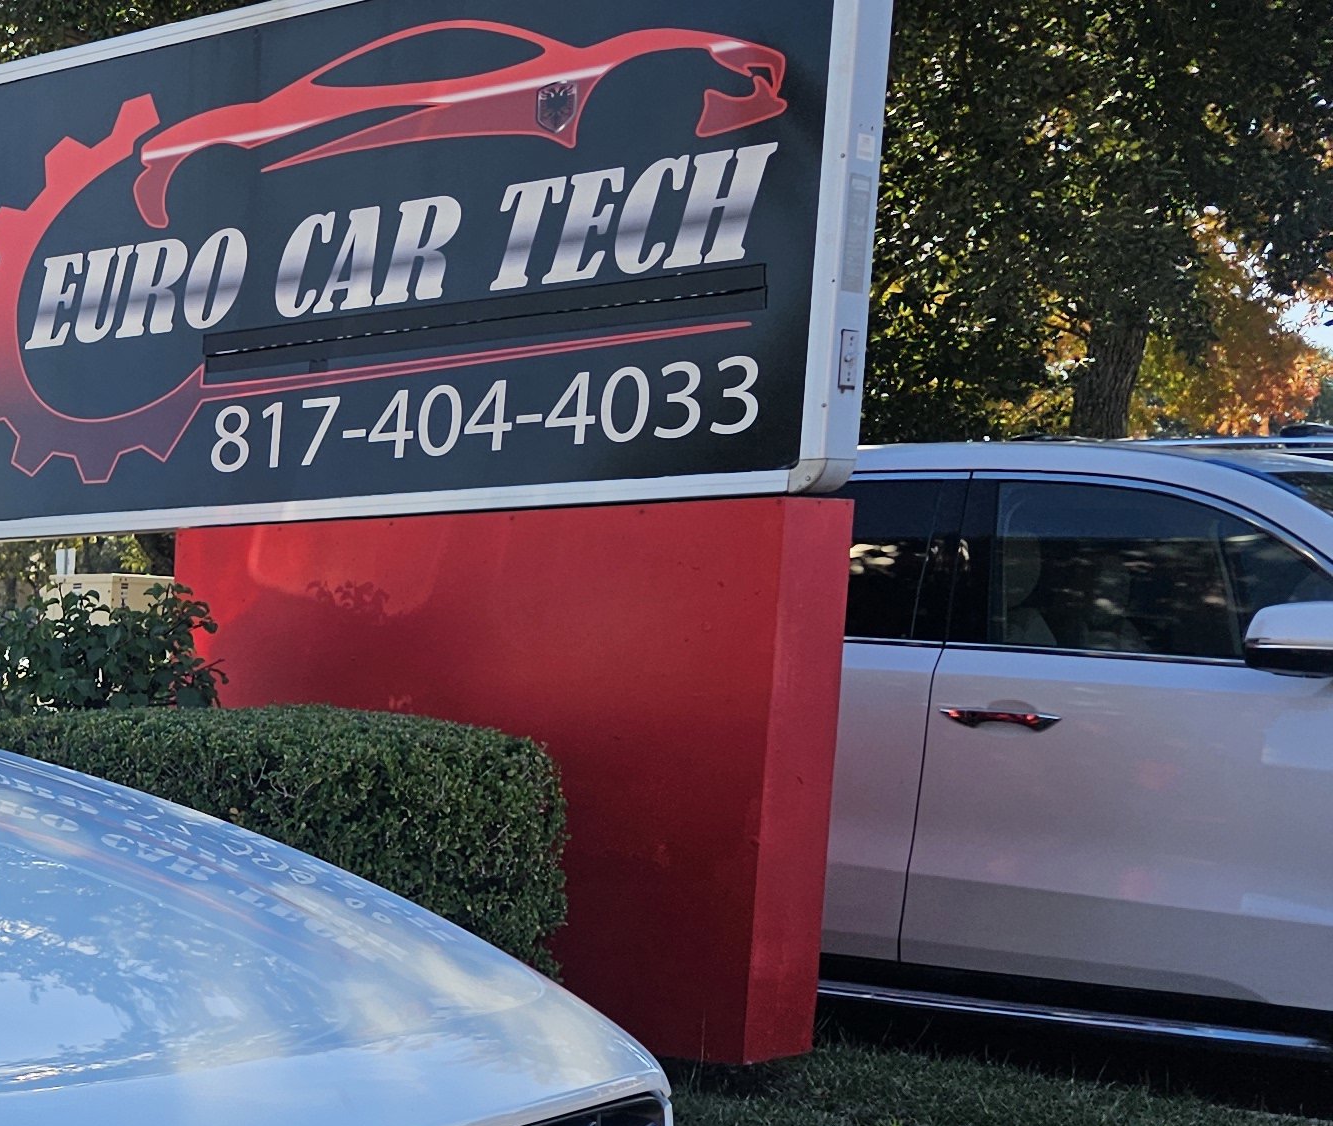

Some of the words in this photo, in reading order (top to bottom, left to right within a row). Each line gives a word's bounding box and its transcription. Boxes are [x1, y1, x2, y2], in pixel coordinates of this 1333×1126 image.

[24, 228, 247, 351] EURO
[274, 195, 462, 318] CAR
[491, 142, 779, 291] TECH
[210, 355, 760, 474] 817-404-4033
